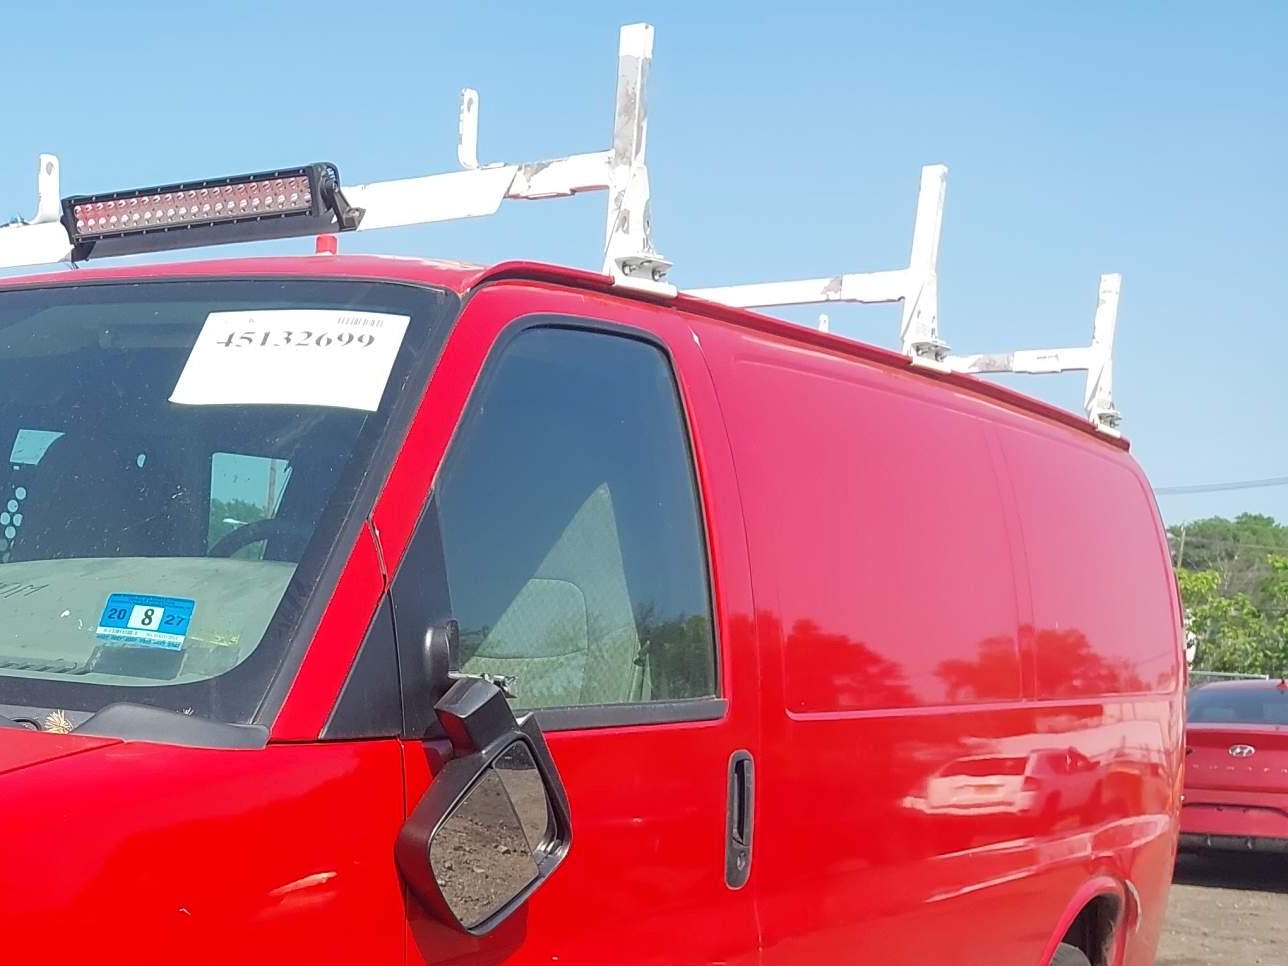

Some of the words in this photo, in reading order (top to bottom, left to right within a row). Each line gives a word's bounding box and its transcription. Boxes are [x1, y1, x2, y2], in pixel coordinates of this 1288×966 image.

[215, 330, 376, 348] 45132699
[107, 608, 127, 620] 20
[141, 608, 154, 626] 8
[164, 614, 185, 626] 27
